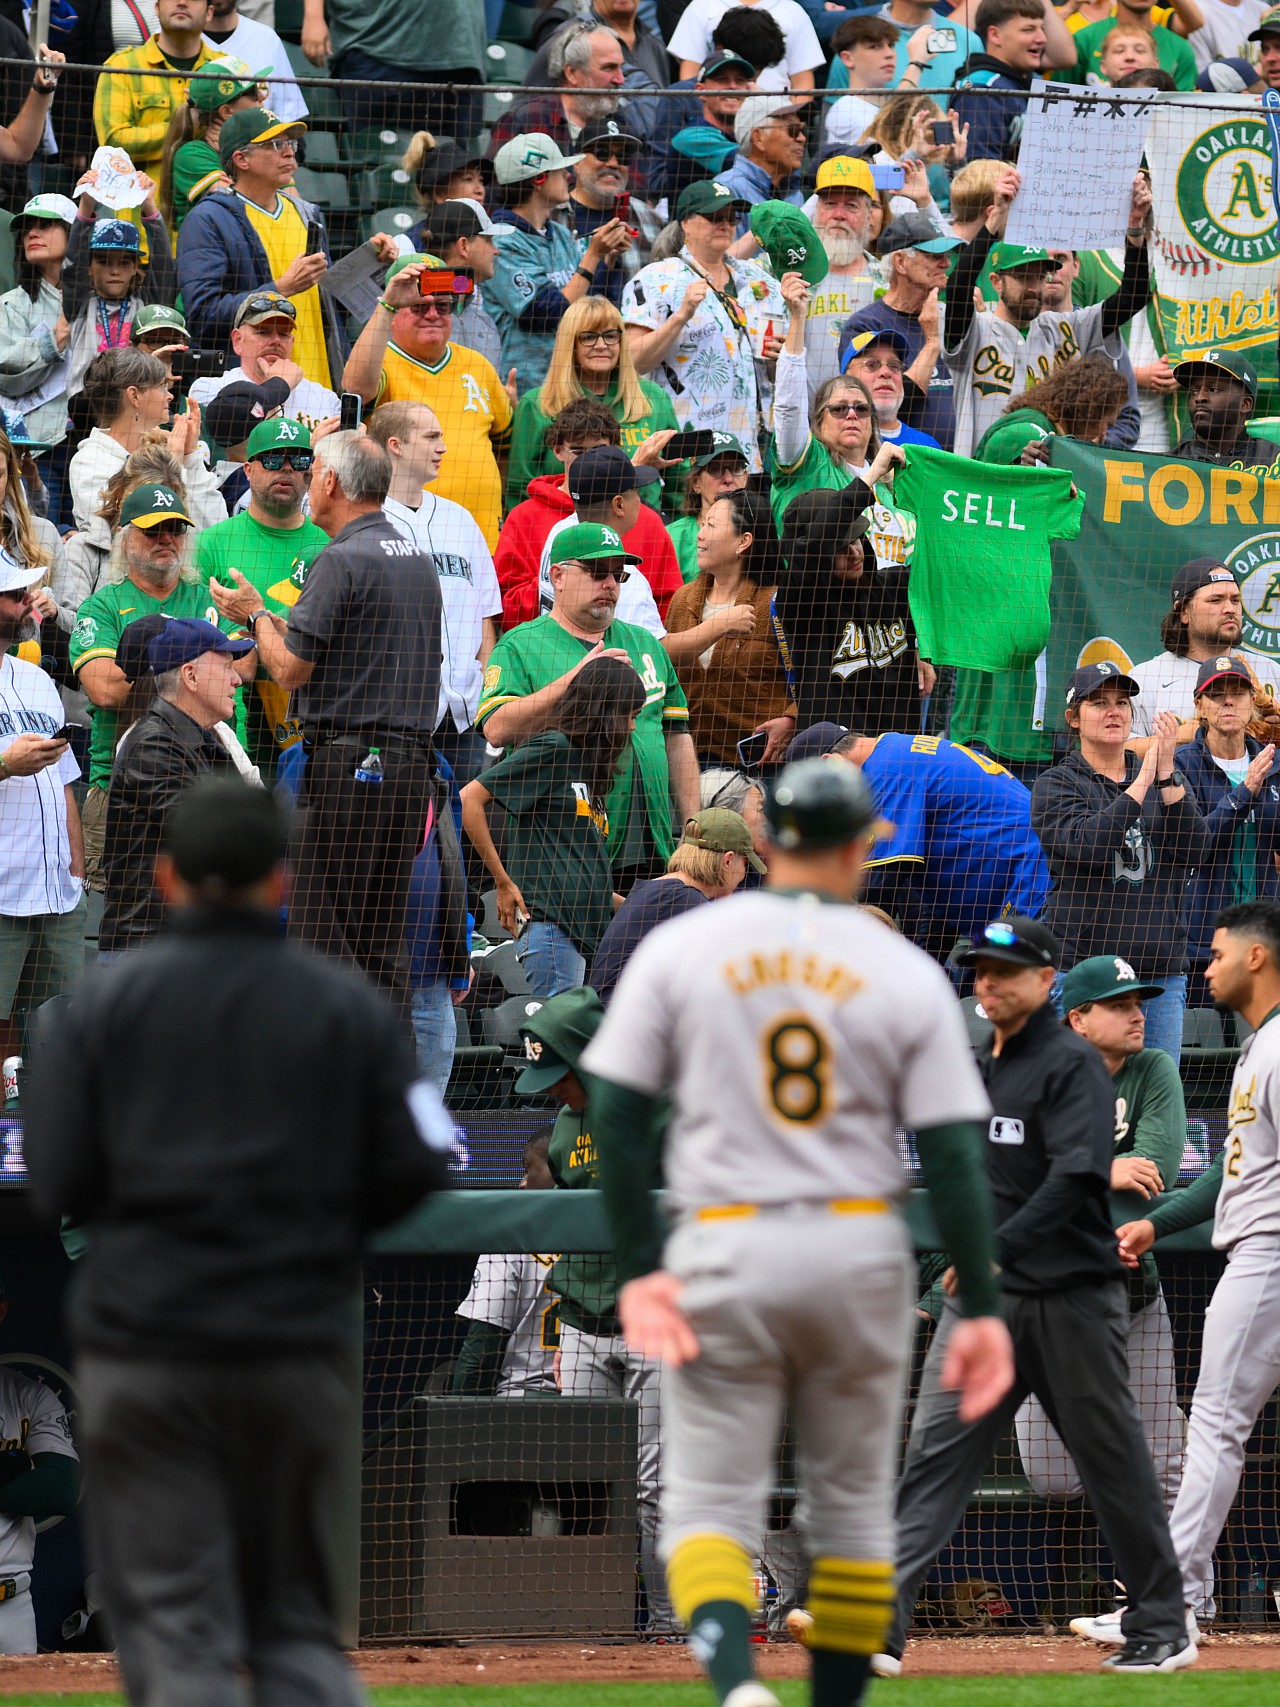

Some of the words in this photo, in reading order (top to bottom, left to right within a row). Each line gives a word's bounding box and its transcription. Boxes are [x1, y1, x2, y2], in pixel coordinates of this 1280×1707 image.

[1195, 127, 1274, 163] OAKLA
[787, 245, 807, 266] A's
[275, 421, 300, 441] A's
[152, 489, 175, 508] A's
[941, 489, 1026, 531] SELL
[763, 1013, 832, 1126] 8
